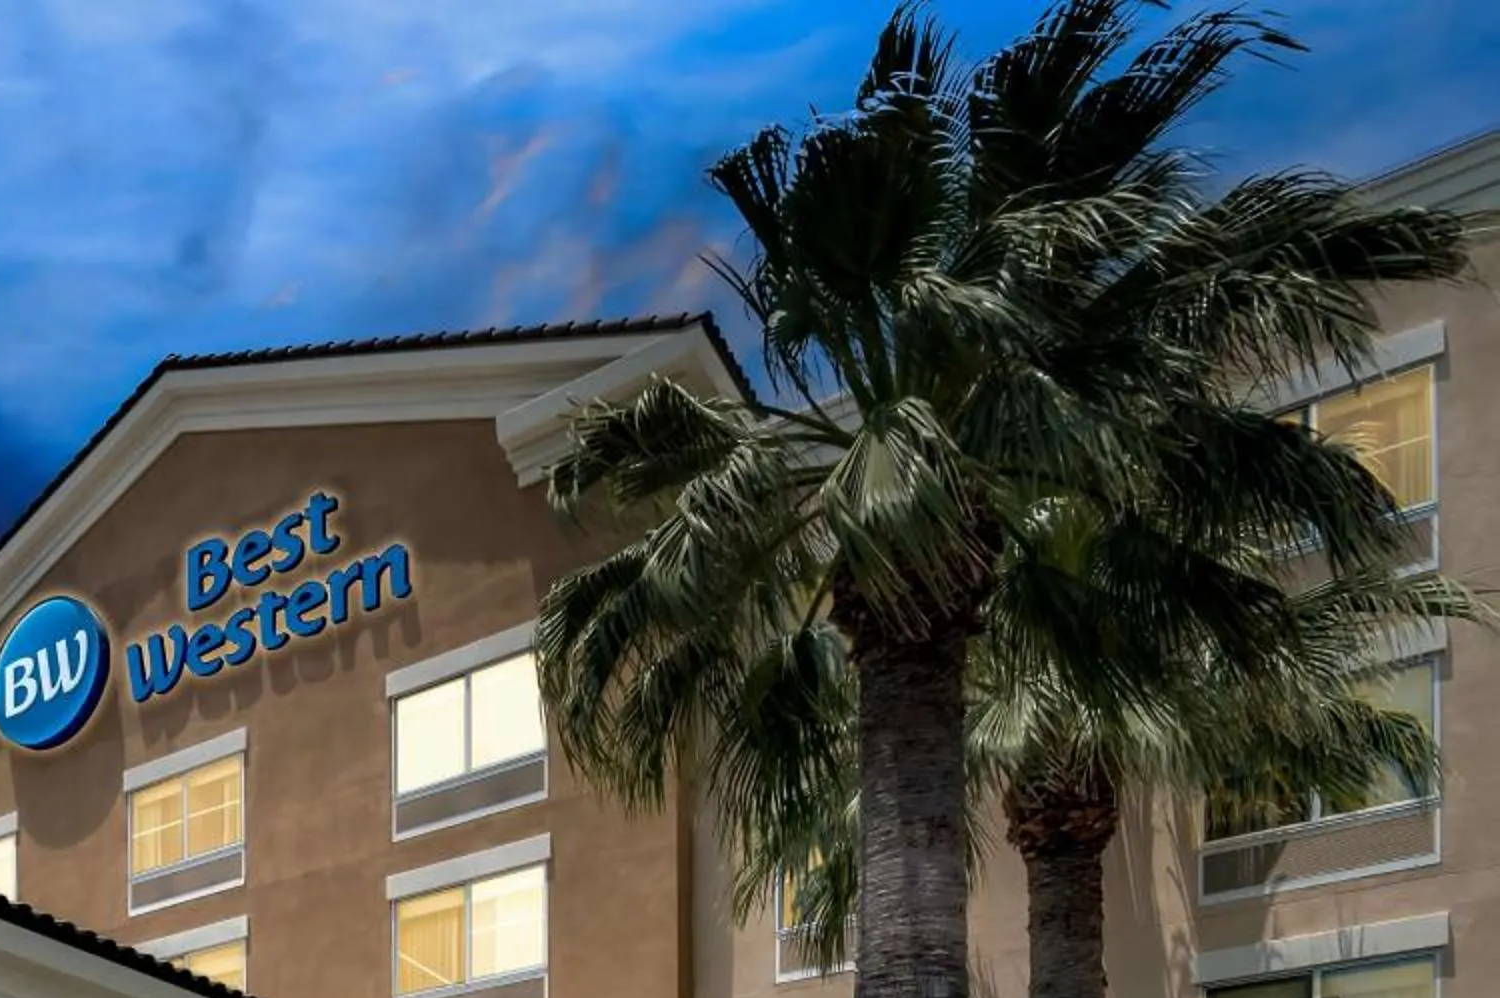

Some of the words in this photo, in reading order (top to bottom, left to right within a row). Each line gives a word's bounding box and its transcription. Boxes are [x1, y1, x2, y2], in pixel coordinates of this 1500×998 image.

[187, 492, 340, 611] Best
[4, 630, 88, 718] BW
[127, 544, 412, 702] Western
